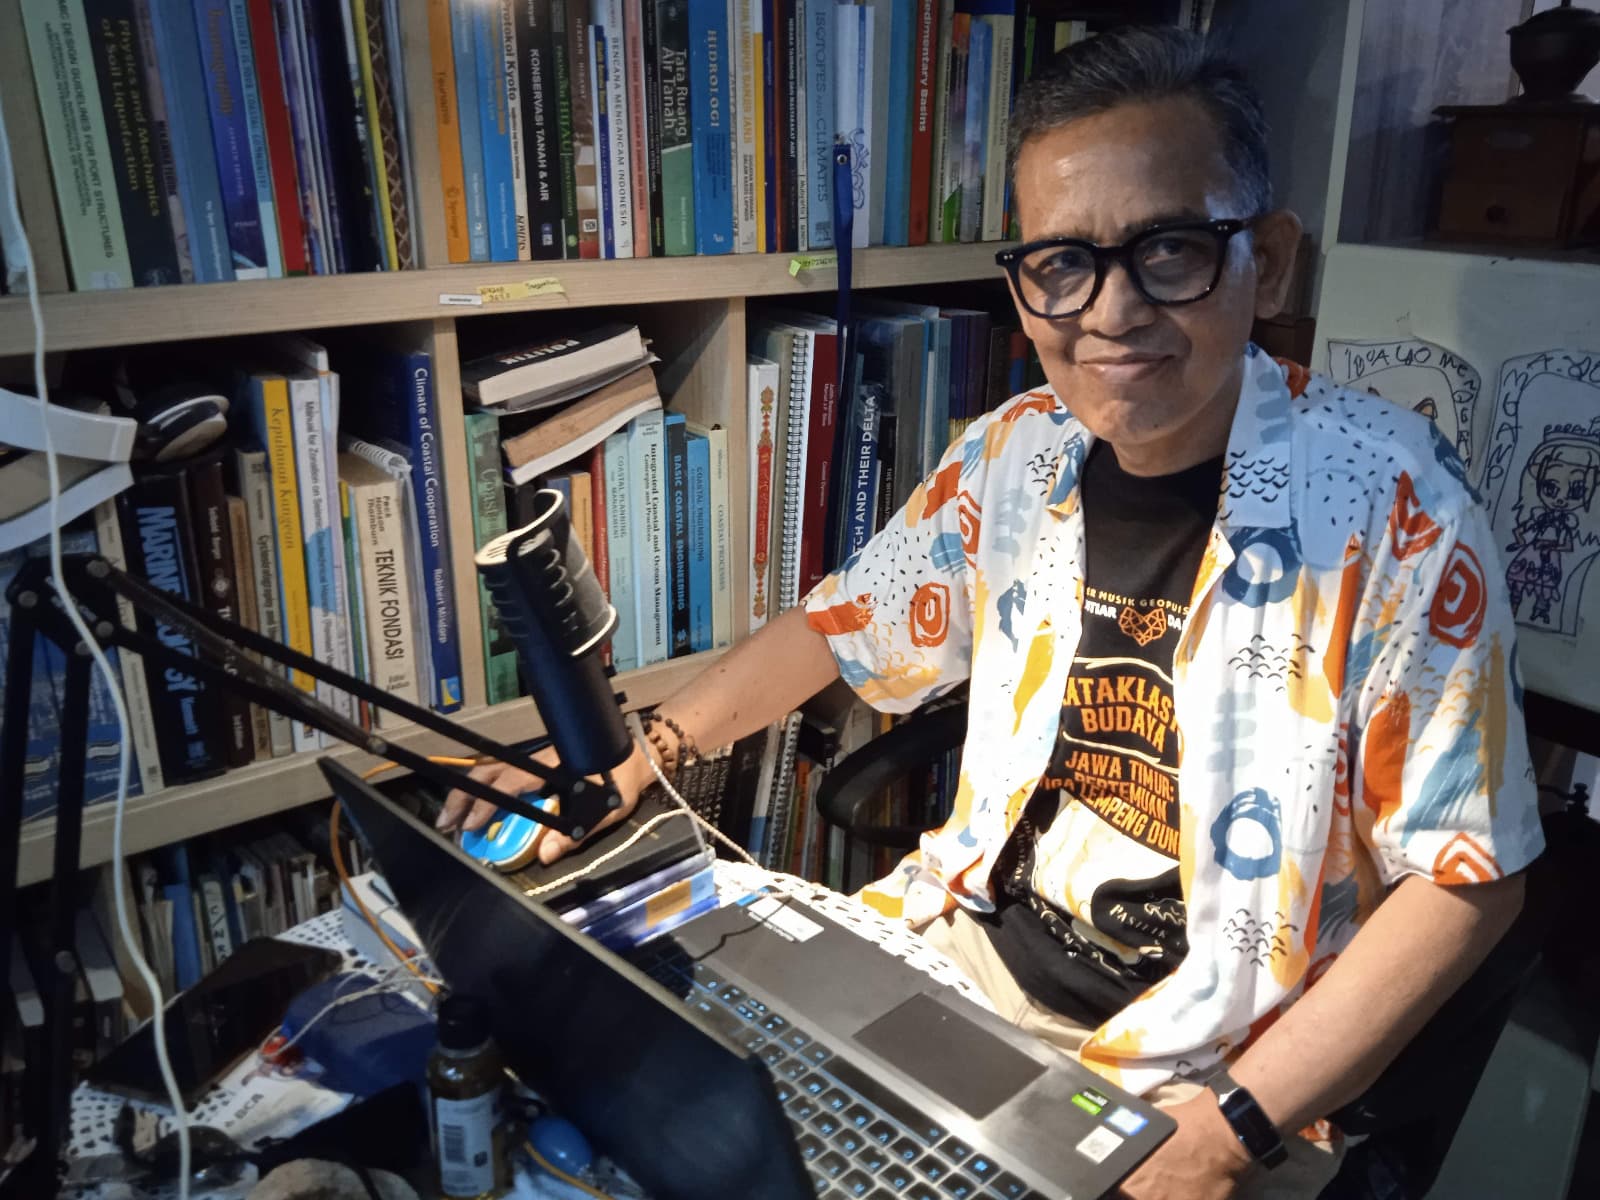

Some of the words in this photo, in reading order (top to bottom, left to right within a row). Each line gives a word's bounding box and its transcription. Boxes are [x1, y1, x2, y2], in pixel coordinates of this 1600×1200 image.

[62, 21, 78, 64] DESIGN
[99, 17, 112, 39] of
[113, 17, 141, 85] Physics
[815, 11, 826, 92] ISOTOPES
[919, 0, 931, 85] edimentary
[104, 43, 120, 77] Soil
[505, 59, 519, 101] Kyoto
[609, 36, 621, 89] BENCANA
[661, 45, 674, 74] Air
[674, 48, 687, 82] Tata
[707, 29, 719, 127] HIDROLOGI
[71, 66, 91, 131] GUIDELINES
[129, 88, 146, 123] and
[528, 47, 544, 126] KONSERVASI
[662, 77, 676, 129] Tanah
[918, 88, 928, 132] Basins
[612, 93, 625, 166] MENGANCAM
[673, 85, 690, 137] Ruang
[83, 133, 96, 156] FOR
[109, 80, 143, 190] Liquefaction
[534, 128, 547, 168] TANAH
[88, 158, 102, 186] PORT
[133, 126, 164, 216] Mechanics
[537, 170, 547, 180] &
[815, 117, 827, 202] CLIMATES
[538, 180, 549, 202] AIR
[615, 168, 627, 227] INDONESIA
[94, 189, 115, 257] STRUCTURES
[498, 338, 581, 366] POLITIK
[413, 366, 431, 416] Climate
[304, 400, 316, 433] Manual
[419, 416, 430, 429] of
[861, 393, 876, 442] DELTA
[267, 407, 293, 485] Kepulauan
[308, 446, 320, 483] Zonation
[419, 431, 437, 475] Coastal
[647, 442, 659, 493] Integrated
[856, 443, 871, 489] THEIR
[615, 454, 626, 490] COASTAL
[642, 453, 651, 489] Concepts
[673, 454, 682, 487] BASIC
[275, 487, 299, 550] Kangean
[422, 476, 444, 548] Cooperation
[609, 486, 621, 539] MANAGEMENT
[650, 496, 660, 531] Coastal
[673, 489, 684, 536] COASTAL
[853, 490, 867, 522] AND
[652, 534, 660, 552] and
[850, 524, 864, 553] TCH
[374, 548, 398, 597] TEKNIK
[652, 554, 661, 584] Ocean
[674, 538, 687, 611] ENGINEERING
[651, 586, 662, 646] Management
[1098, 590, 1136, 607] MUSIK
[379, 598, 404, 661] FONDASI
[1167, 614, 1183, 631] DA
[1063, 676, 1181, 732] ATAKLAS
[1081, 705, 1166, 754] BUDAYA
[1065, 750, 1122, 779] JAWA
[1128, 759, 1175, 803] TIMUR:
